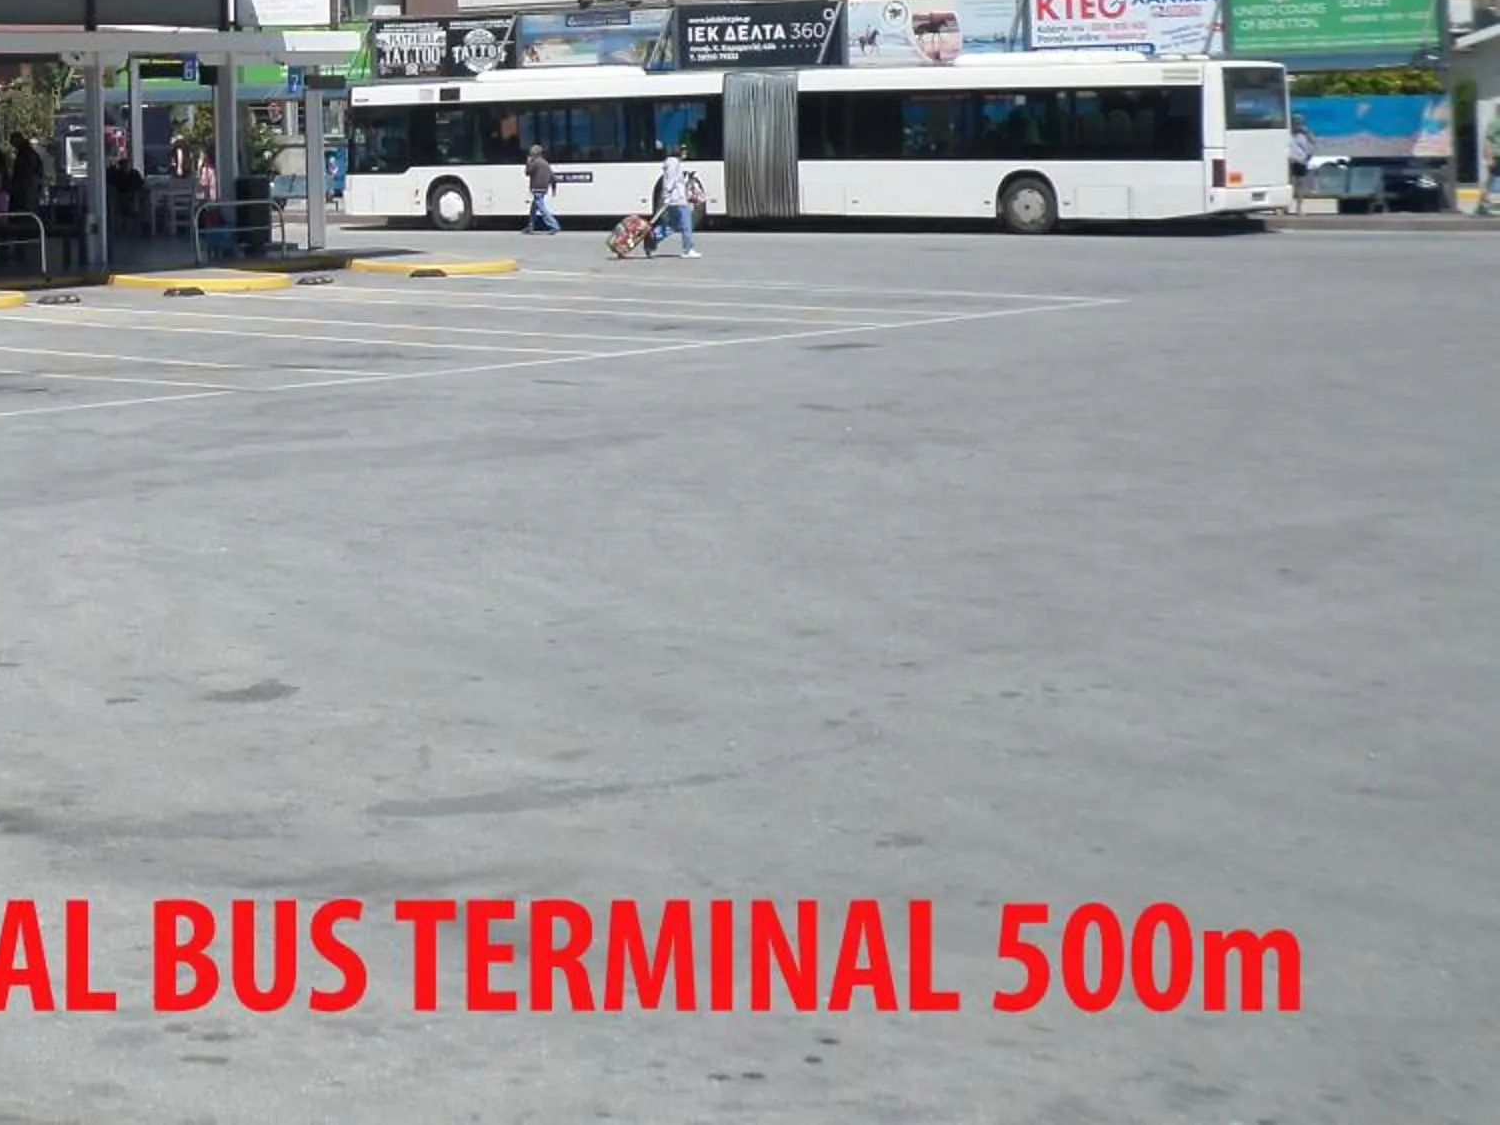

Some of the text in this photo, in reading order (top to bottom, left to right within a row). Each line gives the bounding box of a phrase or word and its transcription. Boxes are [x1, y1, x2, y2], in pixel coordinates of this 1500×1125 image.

[687, 25, 719, 42] ΙΕΚ
[724, 23, 786, 41] ΔΕΛΤΑ
[184, 61, 194, 80] 6
